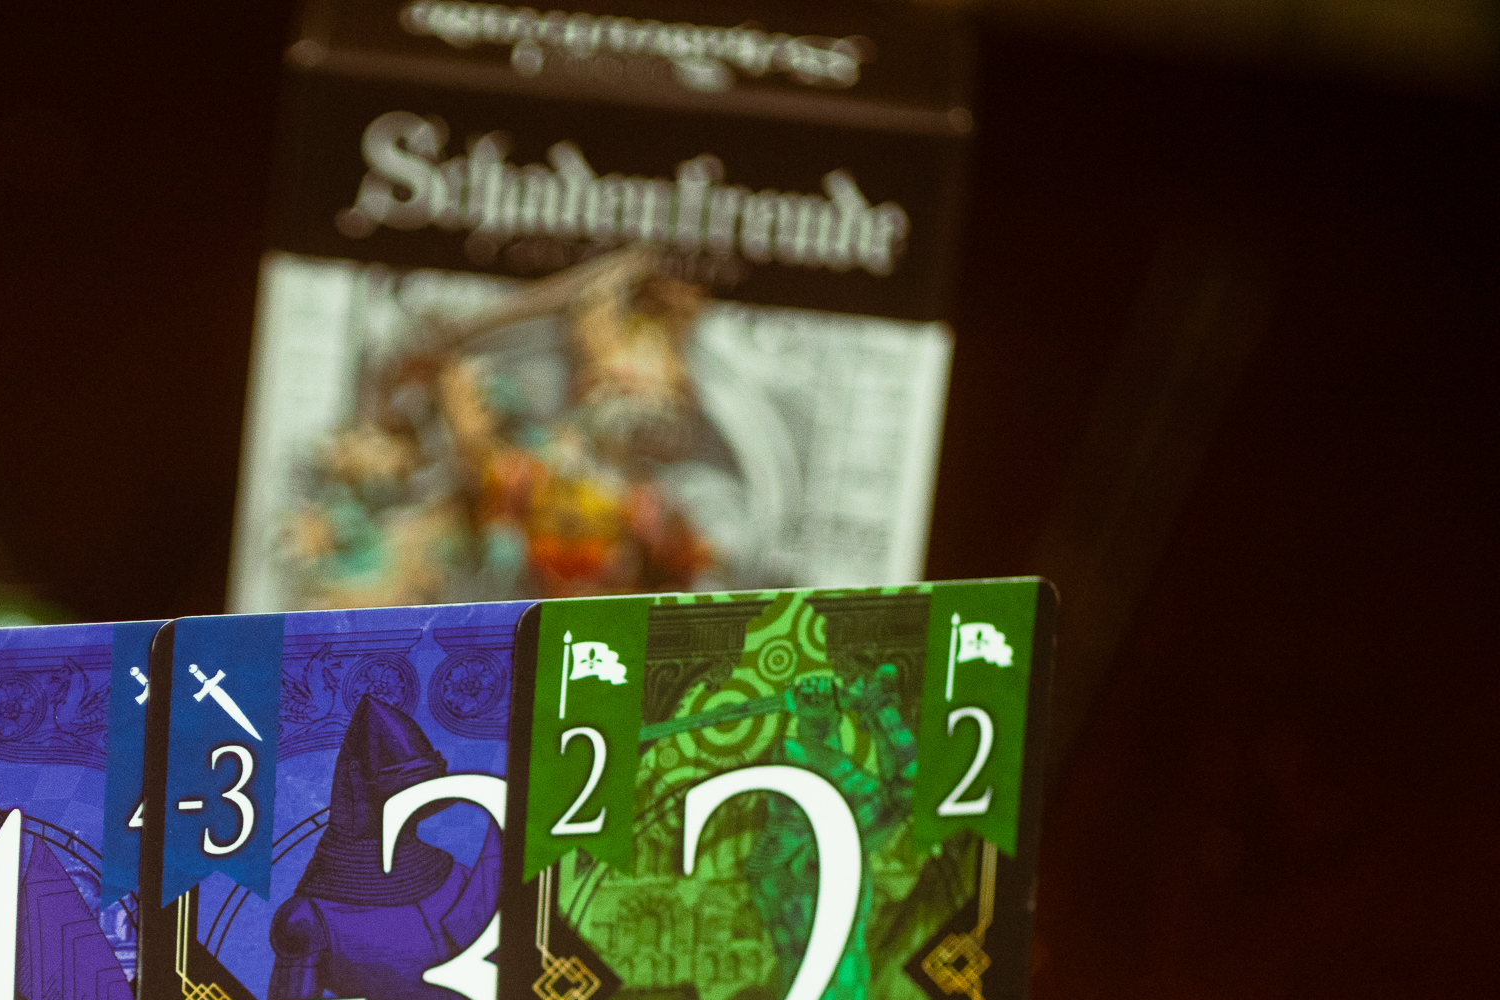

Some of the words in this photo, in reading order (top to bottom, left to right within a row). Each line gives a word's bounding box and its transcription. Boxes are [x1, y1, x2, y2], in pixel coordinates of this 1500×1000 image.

[178, 745, 255, 855] -3
[550, 727, 608, 835] 2
[937, 707, 994, 816] 2
